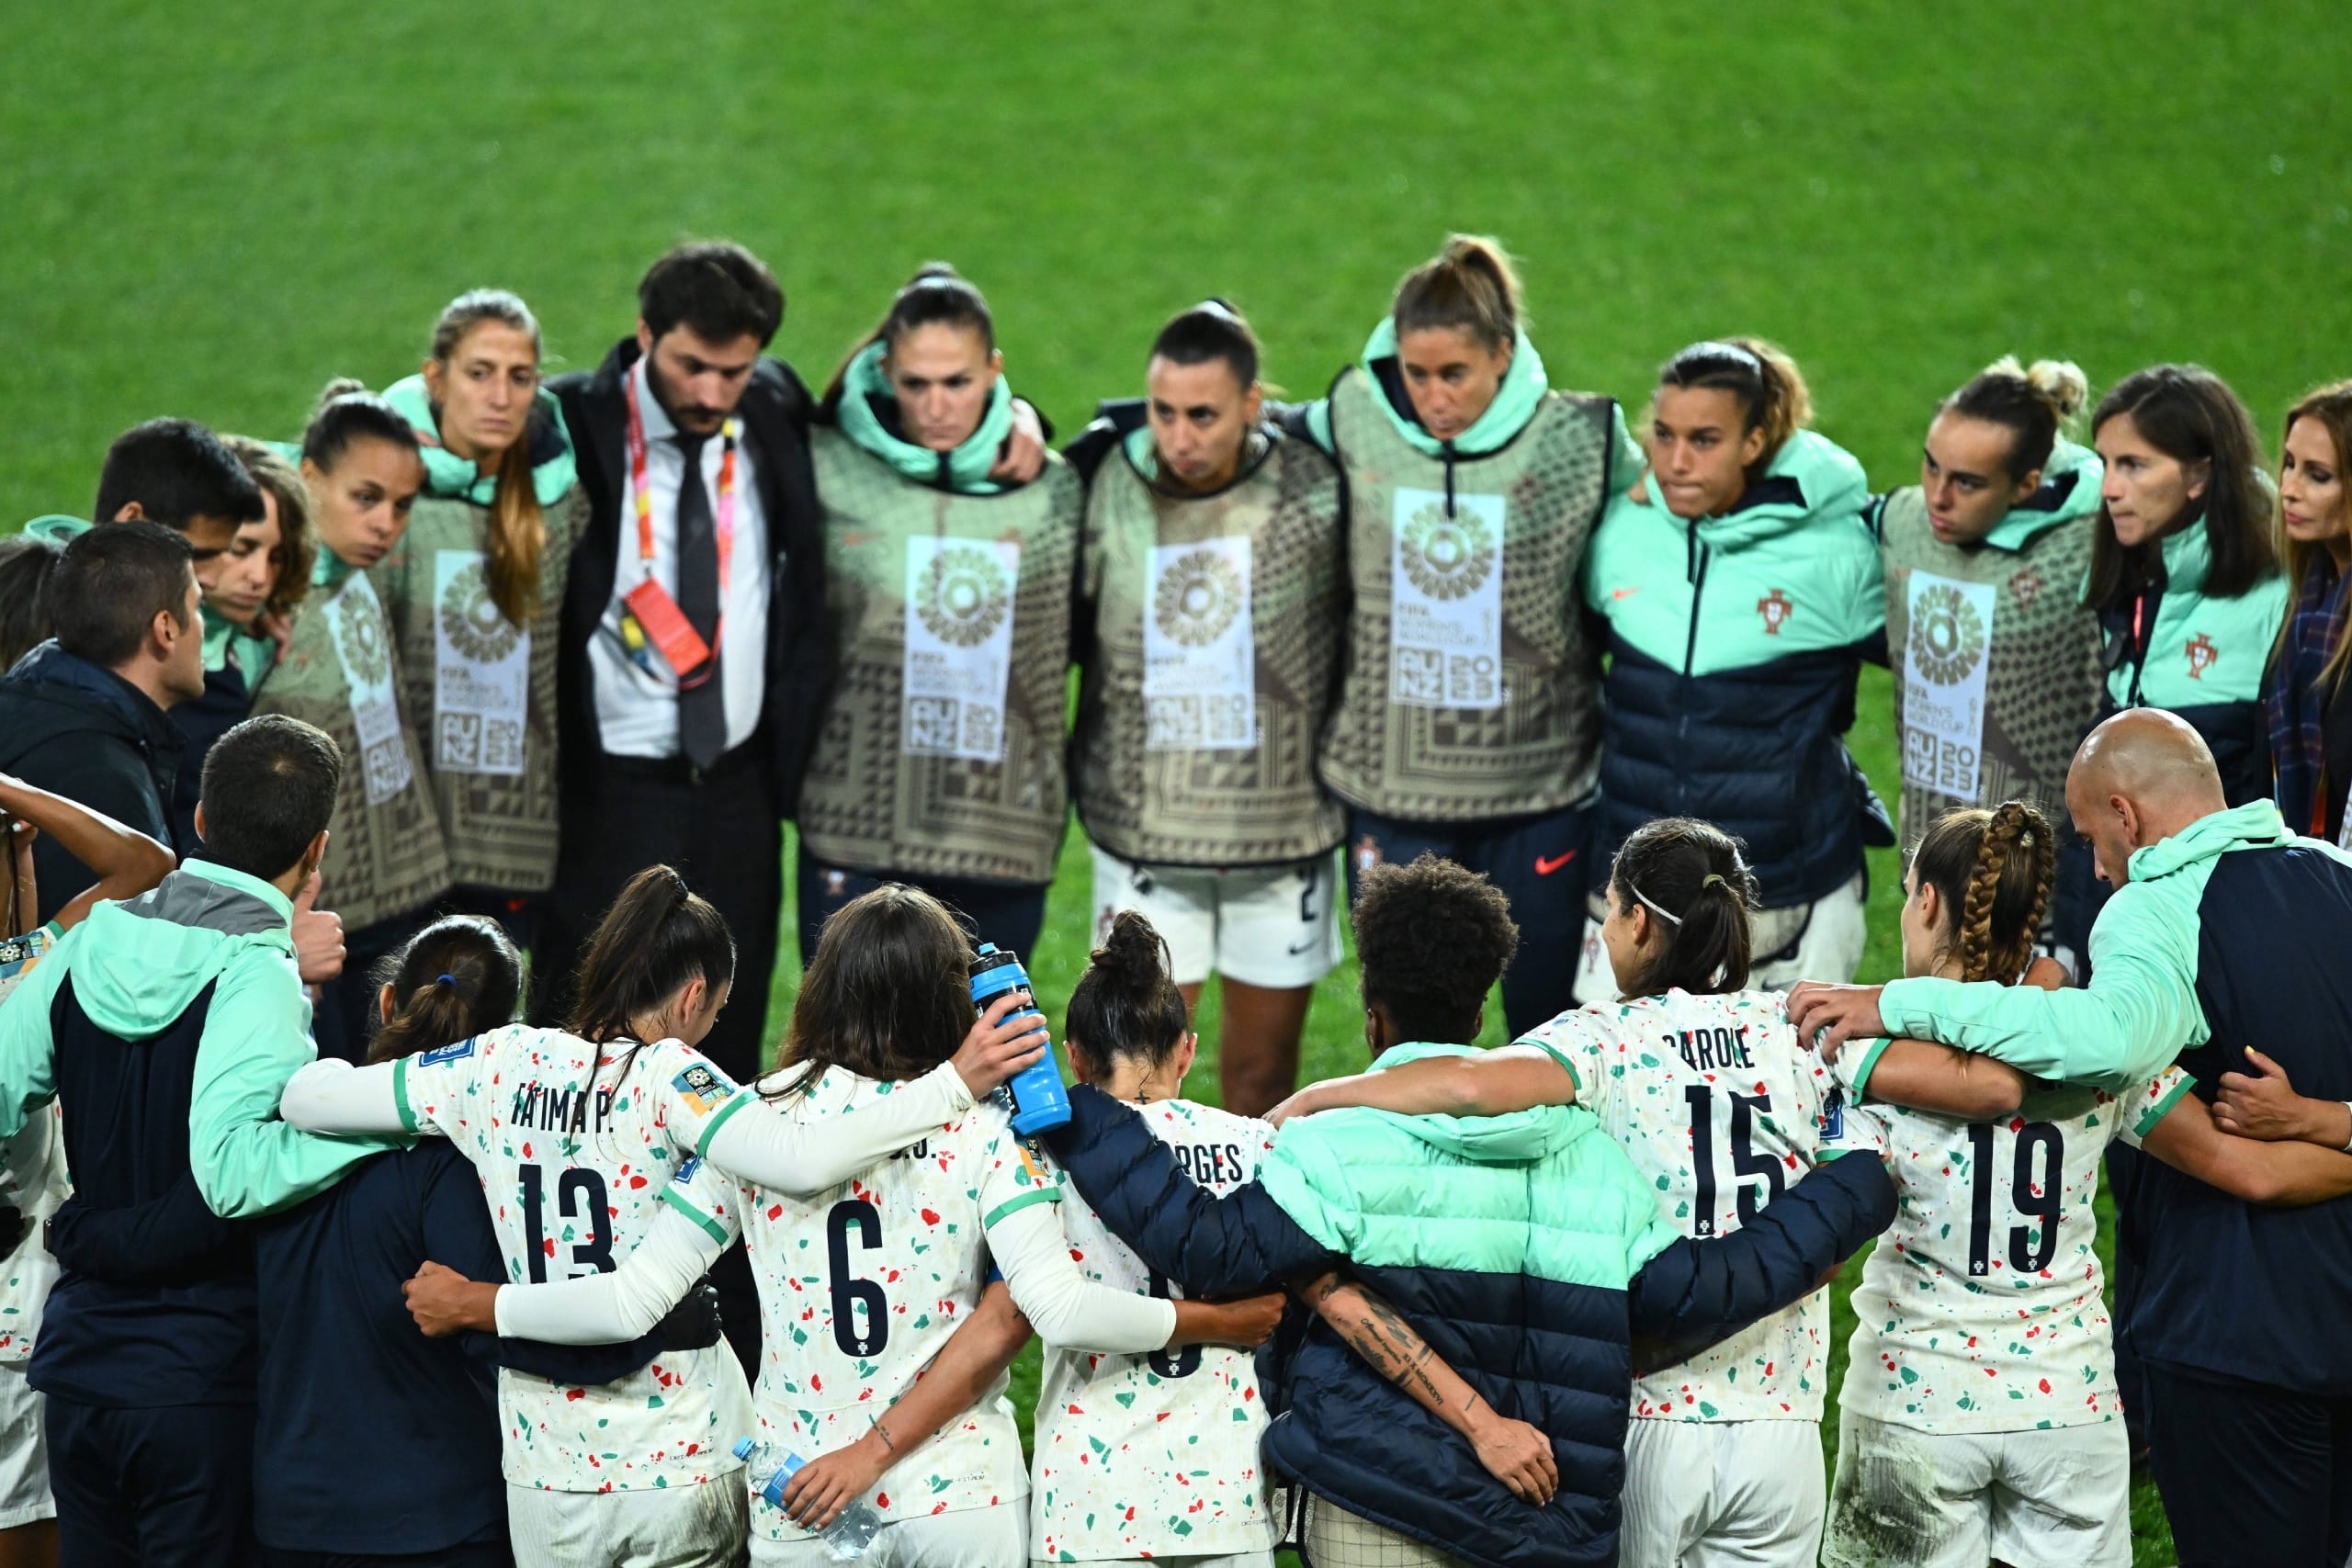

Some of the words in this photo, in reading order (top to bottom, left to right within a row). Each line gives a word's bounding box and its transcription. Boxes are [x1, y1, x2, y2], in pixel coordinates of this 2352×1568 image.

[1940, 764, 1973, 792] 23
[1942, 741, 1975, 768] 20
[519, 1164, 617, 1284] 13
[1685, 1085, 1786, 1235] 15
[1967, 1122, 2064, 1276] 19
[827, 1200, 888, 1357] 6
